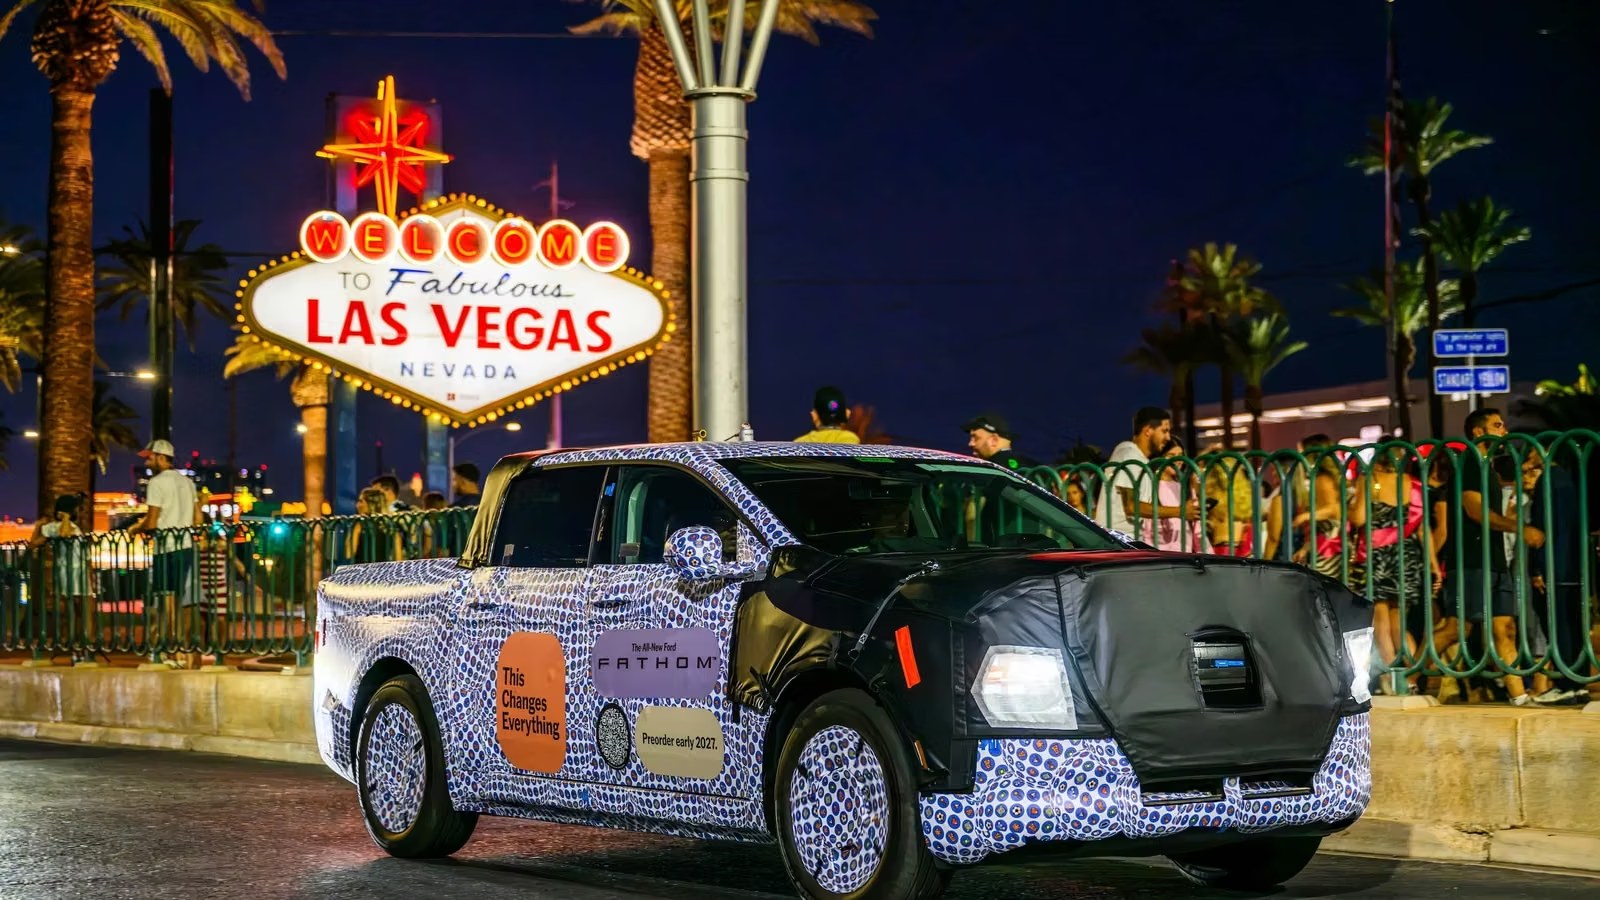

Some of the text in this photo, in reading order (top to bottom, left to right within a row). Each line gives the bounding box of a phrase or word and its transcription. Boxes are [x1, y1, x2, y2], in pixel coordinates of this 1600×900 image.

[310, 223, 616, 262] WELCOME
[338, 267, 575, 297] TO Fabulous
[306, 298, 612, 353] LAS VEGAS
[400, 361, 517, 379] NEVADA
[632, 642, 677, 652] The All-New Ford
[502, 666, 525, 687] This
[502, 689, 547, 715] Changes
[502, 711, 560, 741] Everything
[642, 732, 718, 751] Preorder early 2027.
